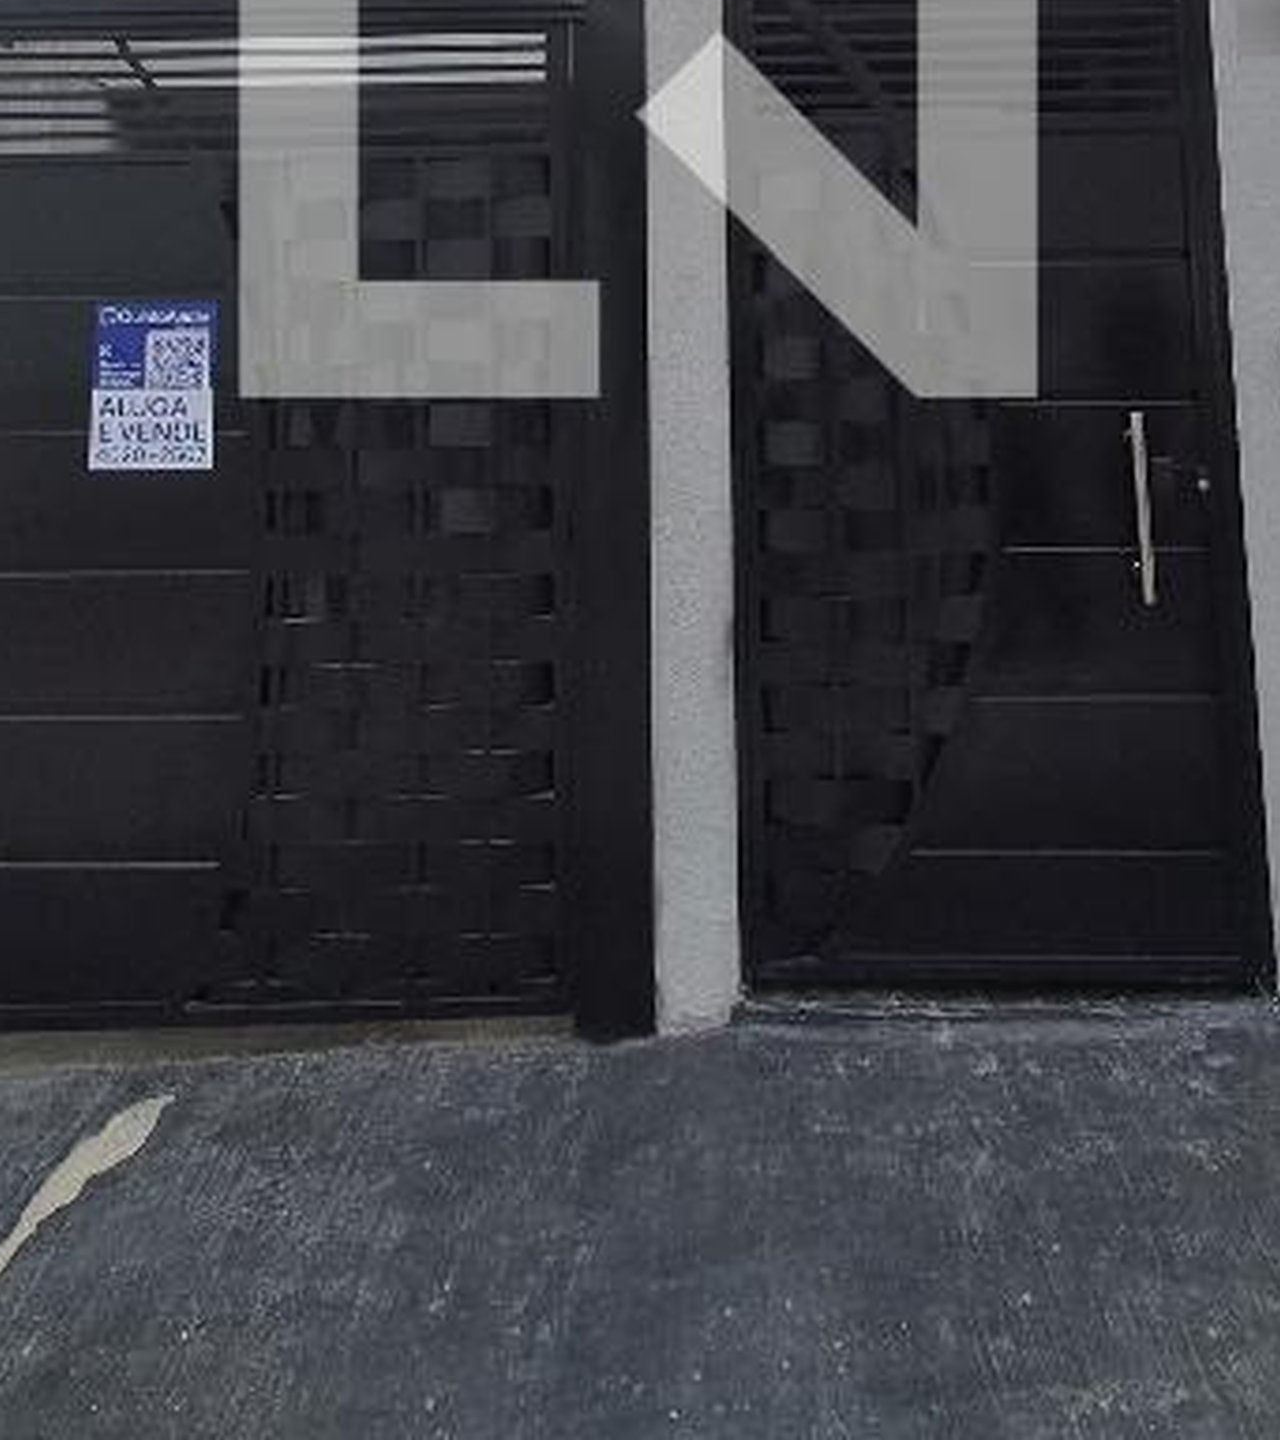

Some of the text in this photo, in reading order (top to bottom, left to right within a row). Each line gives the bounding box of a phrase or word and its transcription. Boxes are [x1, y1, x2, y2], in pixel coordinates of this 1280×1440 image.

[99, 397, 187, 417] ALUGA
[99, 421, 206, 444] E VENDE
